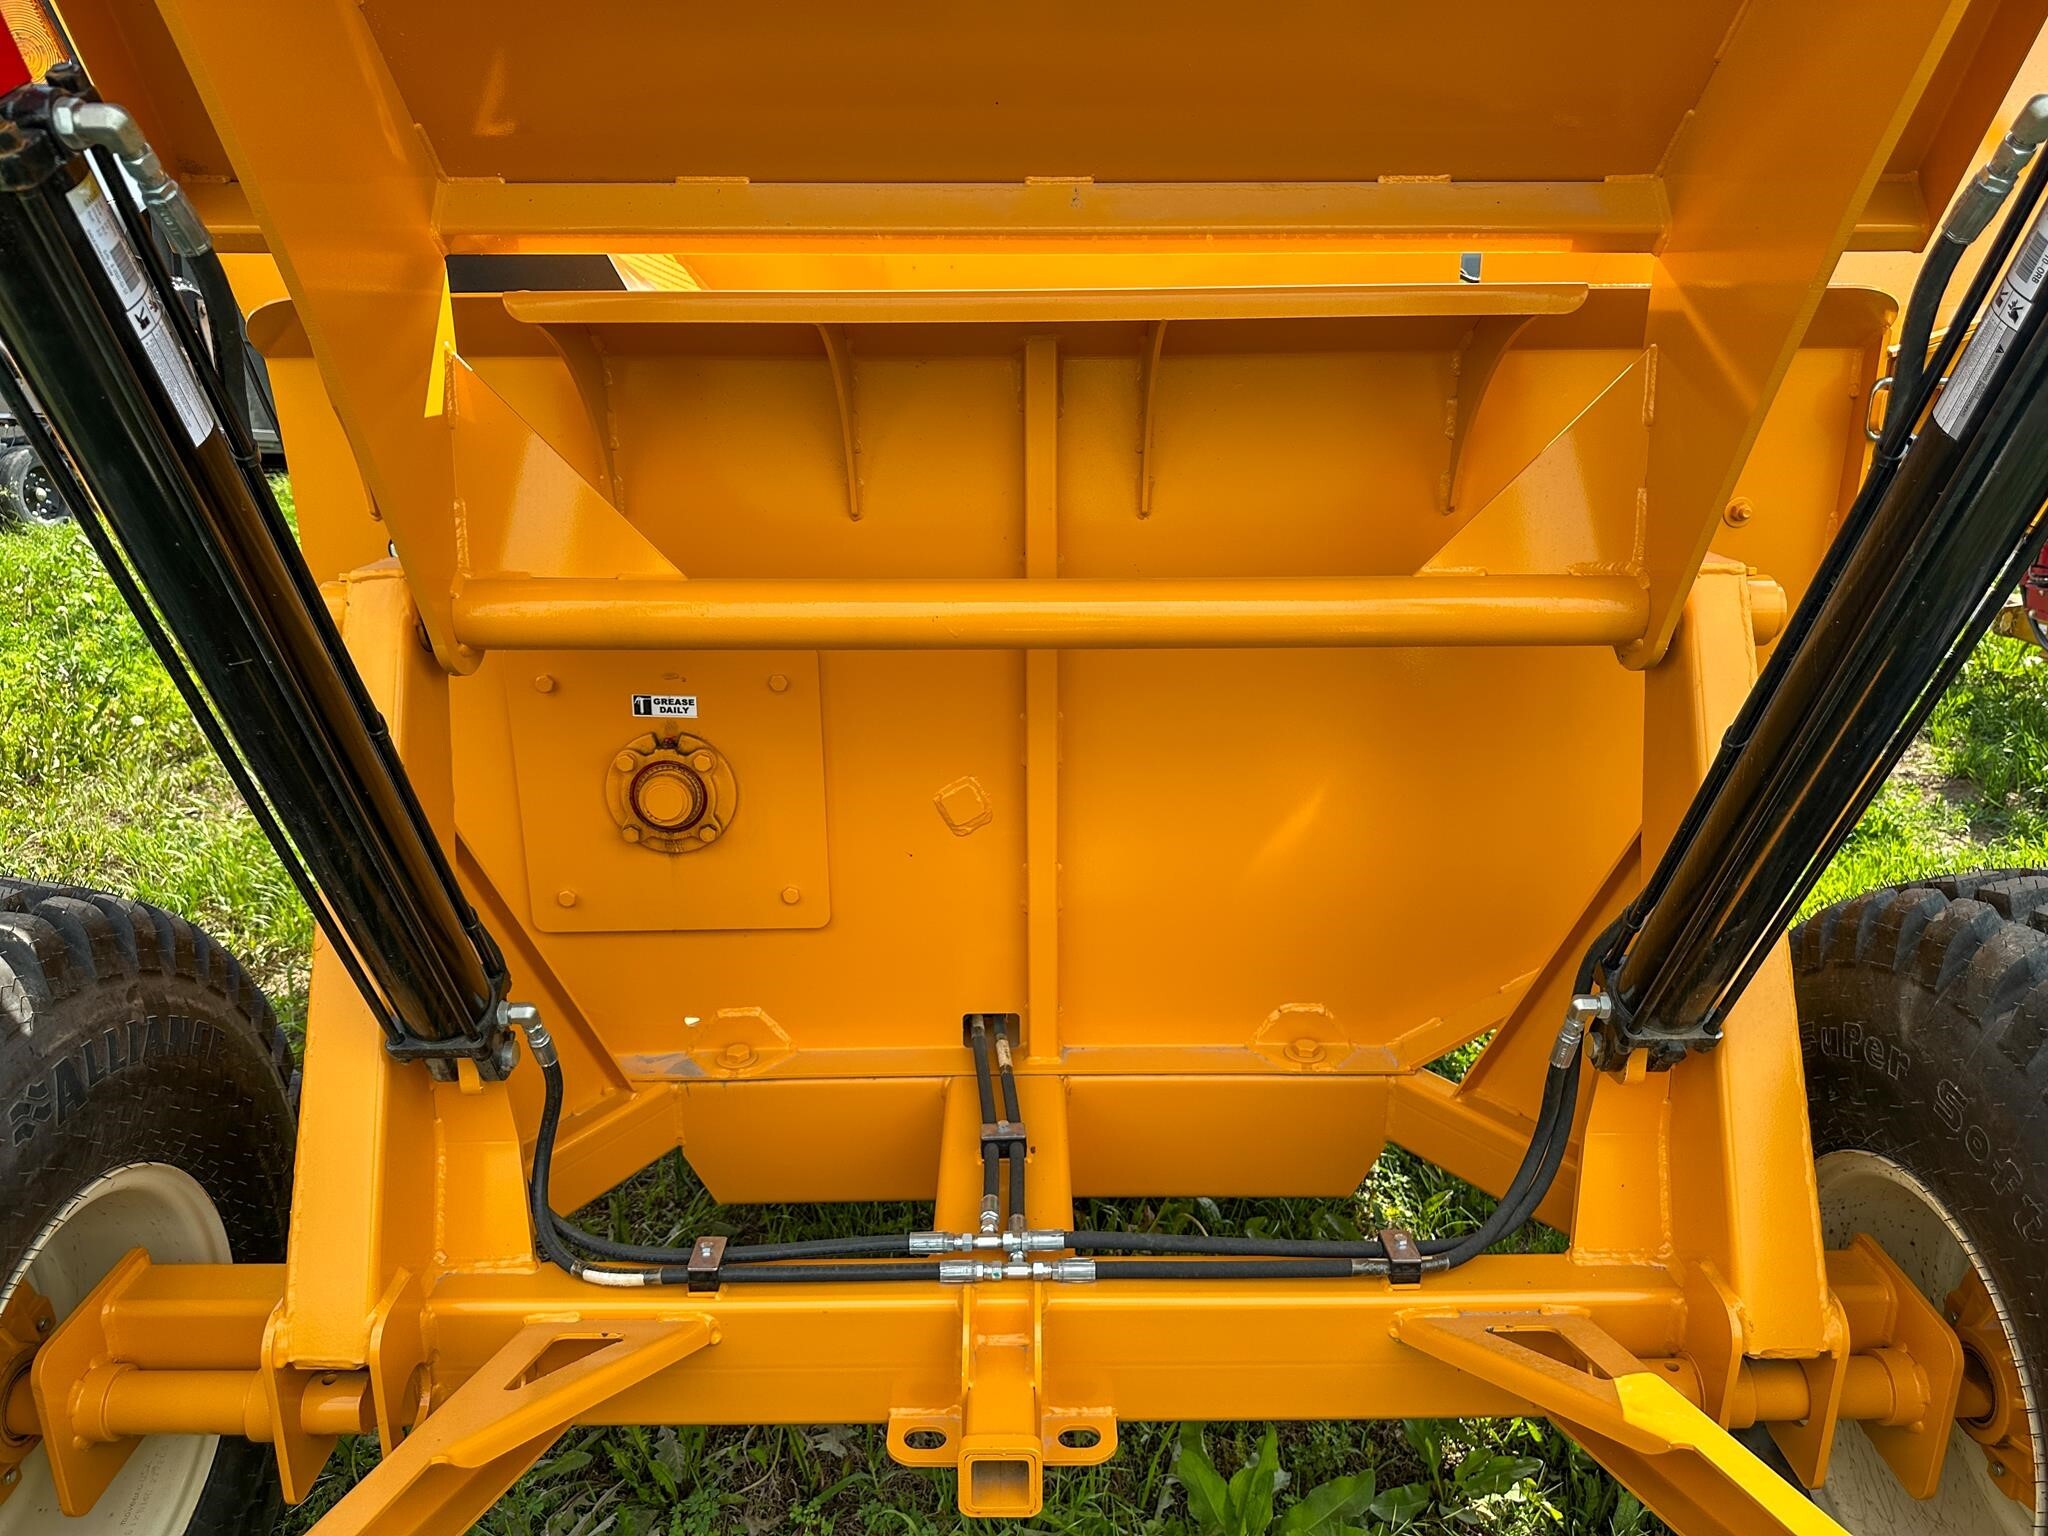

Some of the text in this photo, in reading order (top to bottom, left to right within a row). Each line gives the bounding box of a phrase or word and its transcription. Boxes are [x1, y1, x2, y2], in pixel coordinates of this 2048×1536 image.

[653, 698, 695, 706] GREASE
[660, 706, 689, 714] DAILY
[51, 1015, 226, 1127] ALLIANCE
